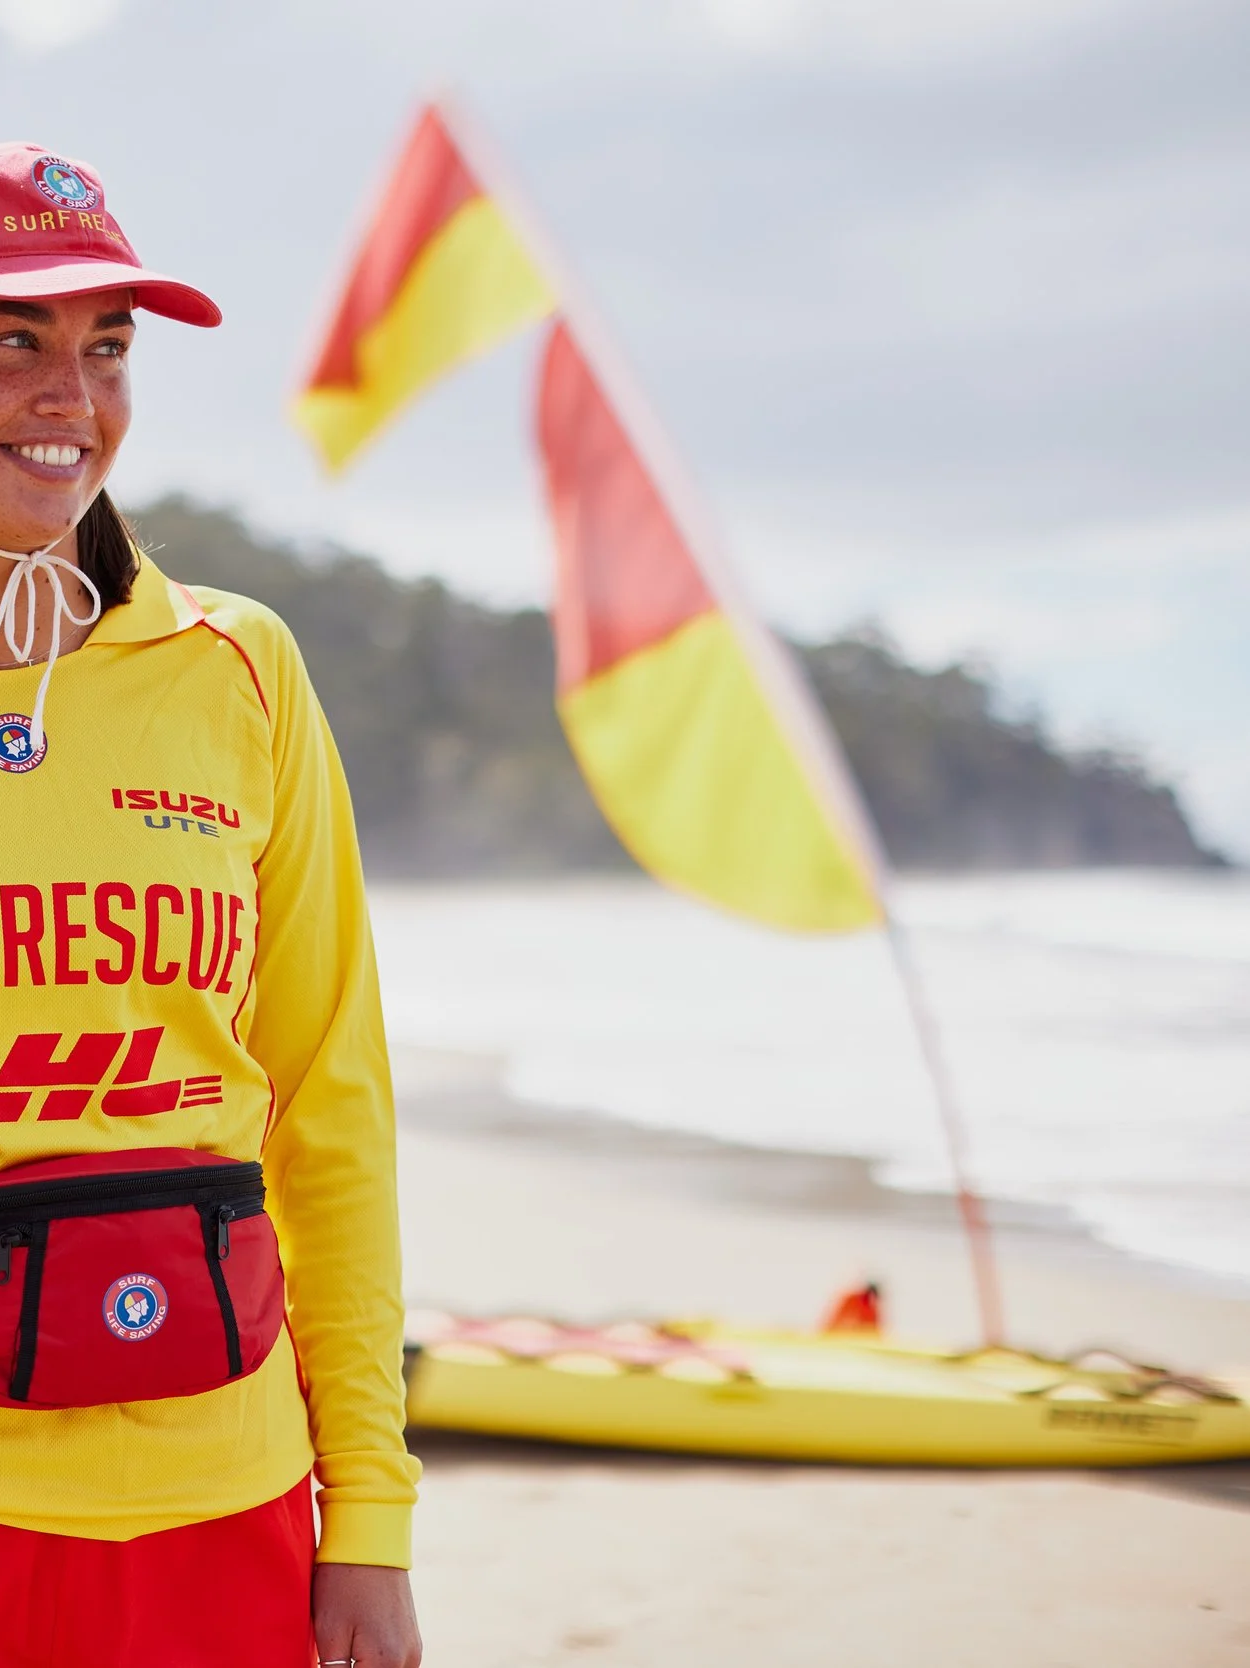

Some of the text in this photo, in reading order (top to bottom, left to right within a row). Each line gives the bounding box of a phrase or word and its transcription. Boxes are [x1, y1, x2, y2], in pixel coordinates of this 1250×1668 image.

[37, 180, 95, 208] LIFE SAVING
[4, 210, 71, 232] SURF
[10, 744, 46, 771] SAVING
[112, 788, 240, 829] ISUZU
[144, 815, 220, 838] UTE
[0, 882, 245, 994] RESCUE
[118, 1275, 156, 1289] SURF
[106, 1305, 166, 1339] LIFE SAVING
